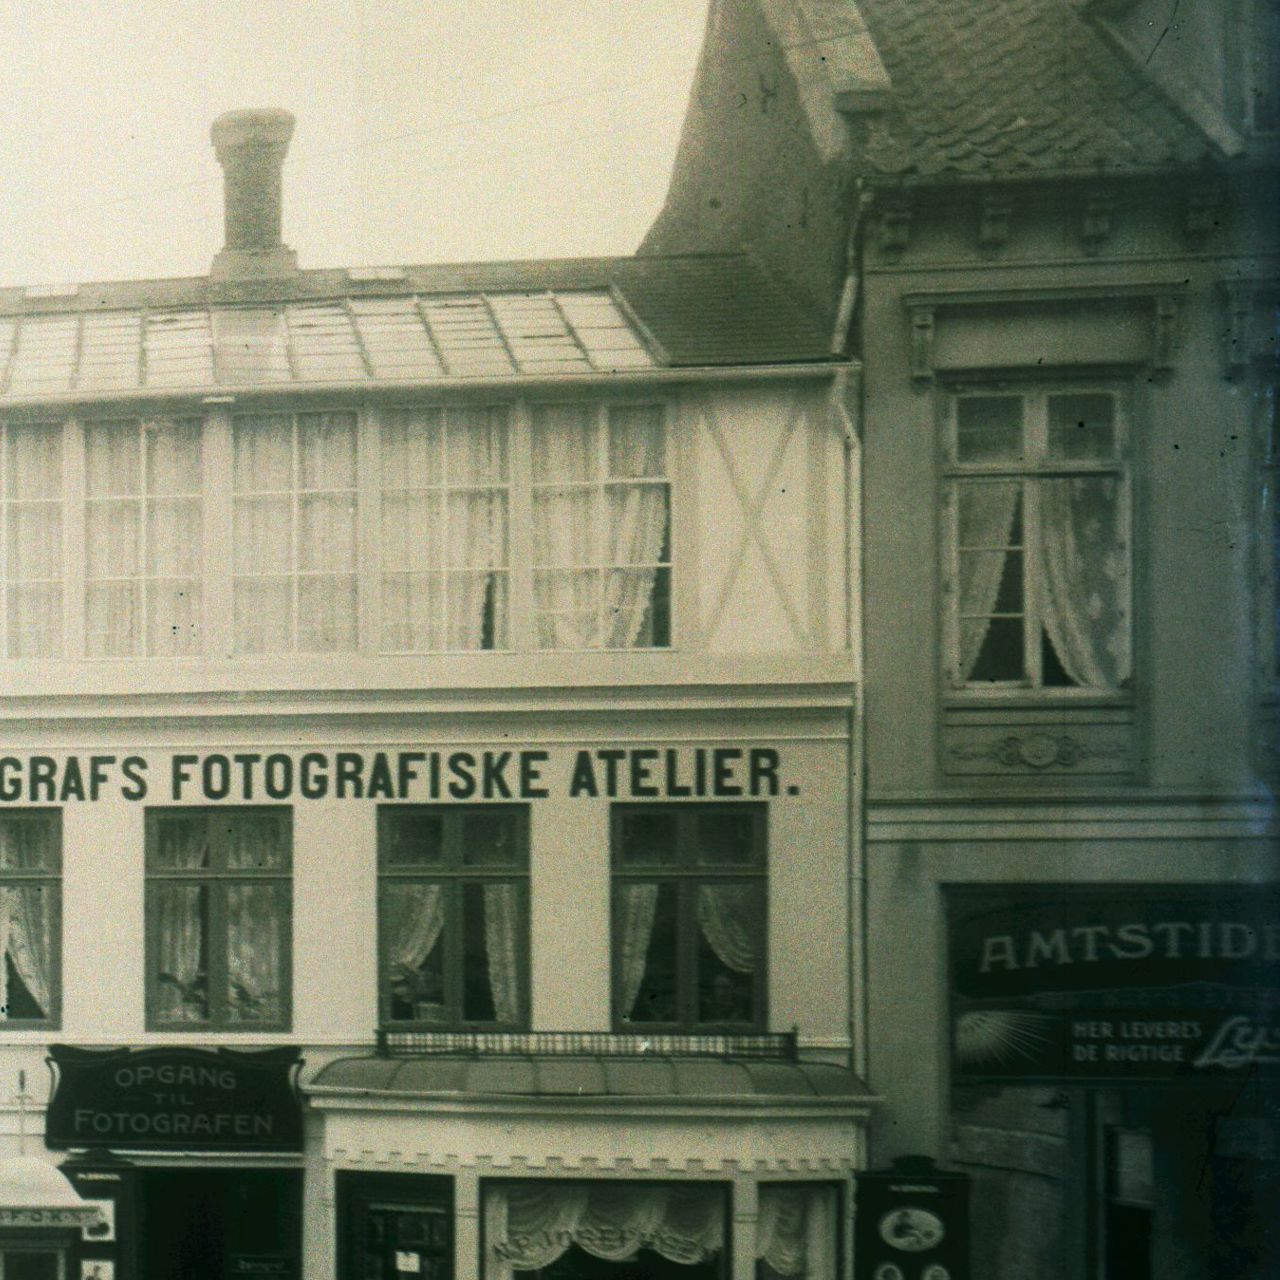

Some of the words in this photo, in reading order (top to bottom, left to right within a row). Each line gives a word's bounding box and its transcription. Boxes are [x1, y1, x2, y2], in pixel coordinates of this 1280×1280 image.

[171, 751, 549, 801] FOTOGRAFISKE
[568, 748, 799, 799] ATELIER.
[1072, 1020, 1115, 1040] HER
[1120, 1019, 1204, 1040] LEVERES
[1072, 1044, 1100, 1062] DE
[1105, 1044, 1187, 1062] RIGTIGE
[114, 1064, 238, 1090] OPGANG
[153, 1092, 195, 1107] TIL
[74, 1108, 275, 1136] FOTOGRAFEN
